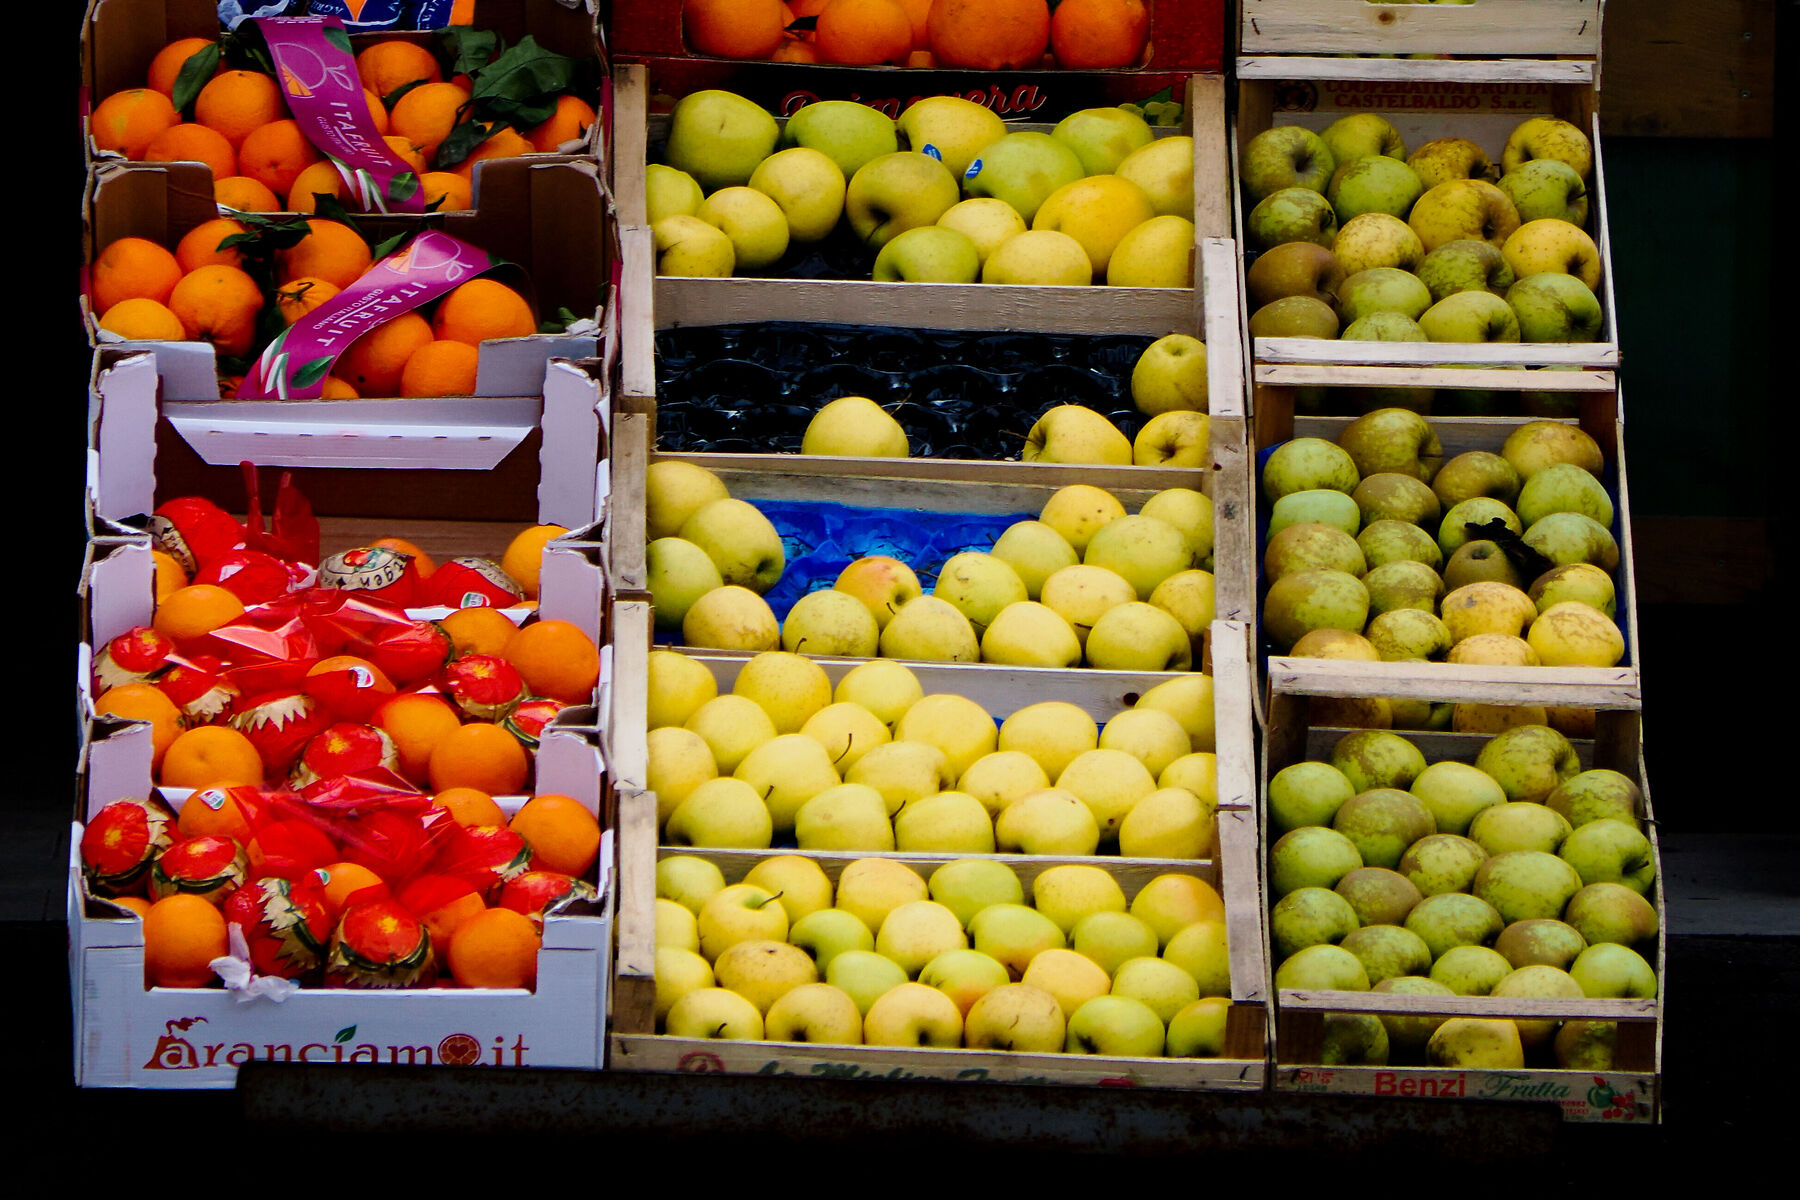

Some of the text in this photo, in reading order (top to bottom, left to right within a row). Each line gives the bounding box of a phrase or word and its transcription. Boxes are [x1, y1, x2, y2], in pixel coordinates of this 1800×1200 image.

[1334, 93, 1481, 109] CASTELBALDO
[1469, 83, 1548, 95] FRUTTA
[329, 101, 393, 167] ITAFRUIT
[317, 281, 428, 347] ITAFRUIT
[1375, 1072, 1570, 1098] Benzi Frutta
